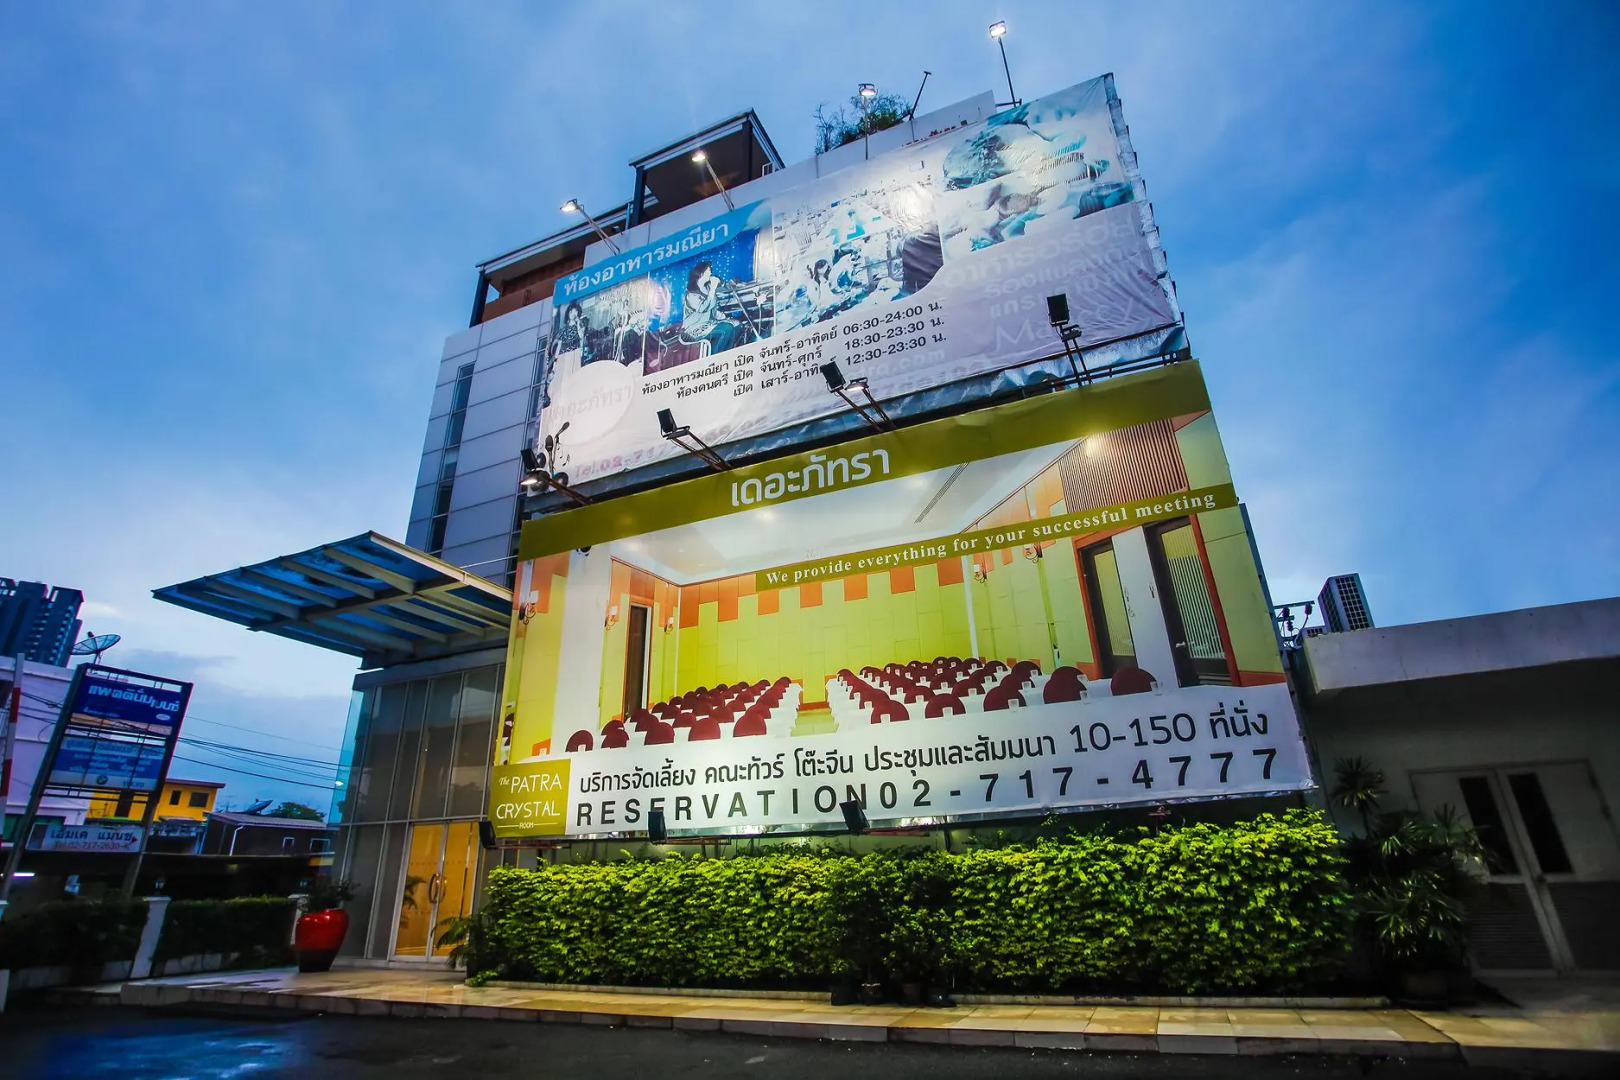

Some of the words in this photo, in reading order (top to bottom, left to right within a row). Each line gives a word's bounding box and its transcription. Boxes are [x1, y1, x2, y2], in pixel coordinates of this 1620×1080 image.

[563, 221, 729, 296] ห้องอาหารมณียา
[642, 361, 730, 395] ห้องอาหารมณียา
[733, 352, 755, 369] เปิด
[759, 324, 838, 359] จันทร์-อาทิตย์
[842, 304, 923, 336] 06:30-24:00
[928, 300, 943, 312] น.
[676, 376, 730, 400] ห้องดนตรี
[733, 368, 754, 384] เปิด
[759, 346, 823, 375] จันทร์-ศุกร์
[844, 319, 925, 351] 18:30-23:30
[929, 316, 945, 328] น.
[732, 383, 754, 399] เปิด
[845, 337, 927, 367] 12:30-23:30
[931, 332, 947, 344] น.
[730, 447, 891, 508] เดอะภัทรา
[765, 570, 790, 586] We
[793, 558, 853, 584] provide
[856, 542, 948, 575] everything
[953, 535, 980, 553] for
[984, 527, 1028, 552] your
[1032, 507, 1128, 540] successful
[1134, 490, 1216, 520] meeting
[579, 758, 697, 794] บริการจัดเลี้ยง
[704, 752, 785, 785] คณะทัวร์
[794, 746, 854, 778] โต๊ะจีน
[863, 735, 1057, 777] ประชุมและสัมมนา
[1069, 712, 1197, 754] 10-150
[1209, 700, 1270, 741] ที่นั่ง
[495, 799, 561, 820] CRYSTAL
[499, 776, 511, 788] The
[511, 773, 563, 794] PATRA
[518, 821, 535, 830] ROOM
